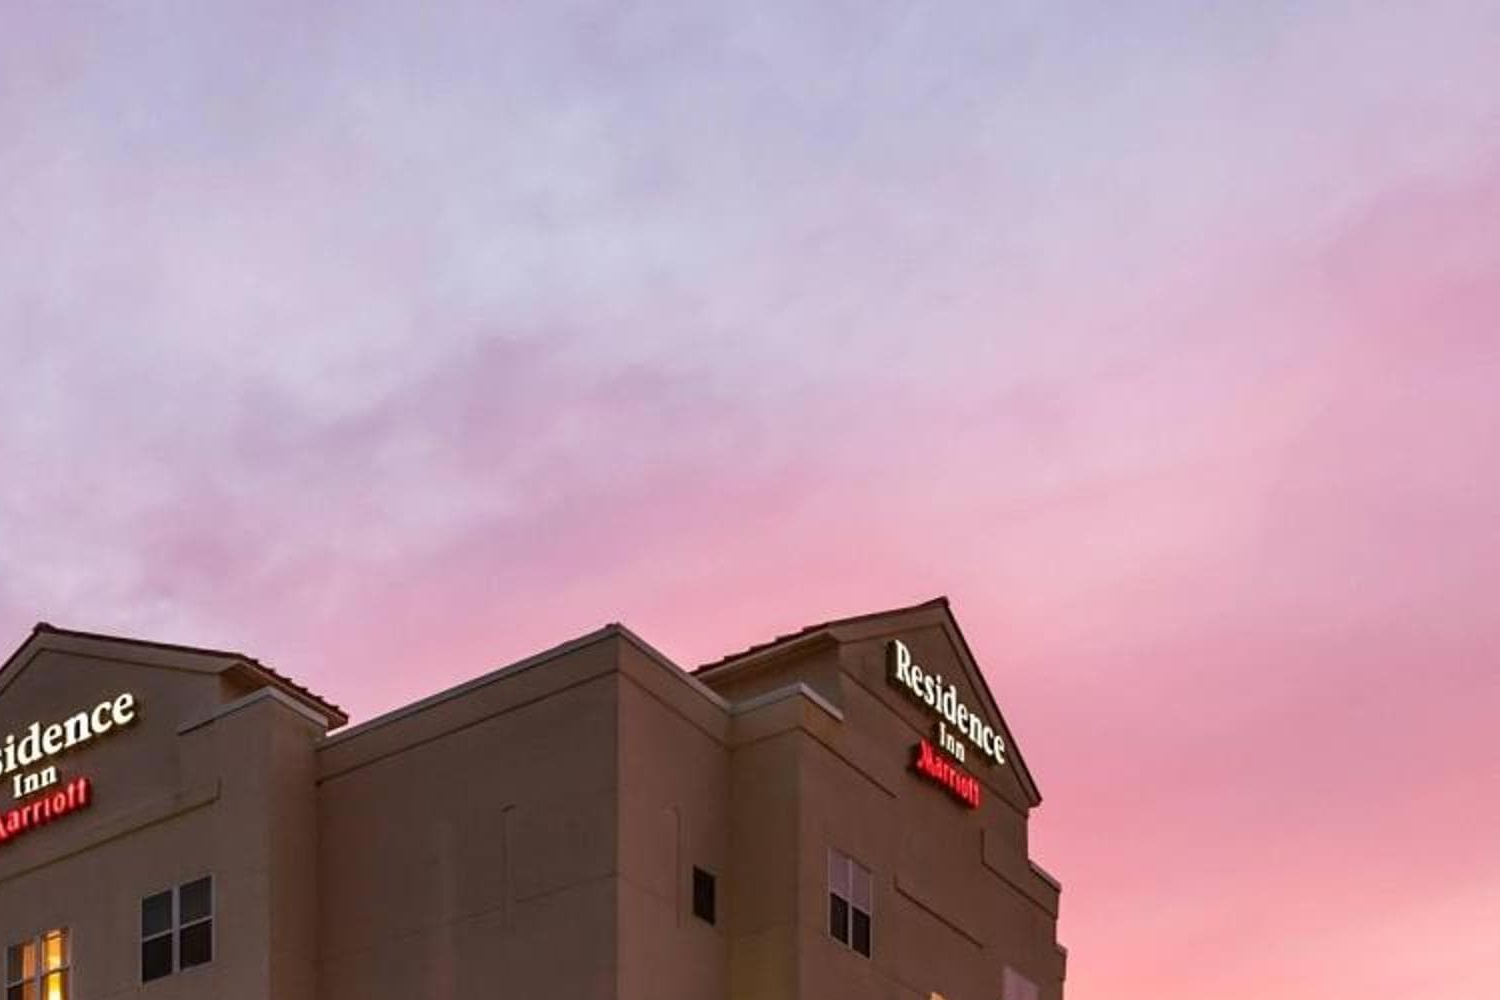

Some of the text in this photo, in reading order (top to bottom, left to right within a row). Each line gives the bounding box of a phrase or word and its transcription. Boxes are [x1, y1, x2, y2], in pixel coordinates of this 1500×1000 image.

[895, 639, 1005, 765] Residence
[938, 721, 966, 763] Inn
[13, 765, 58, 798] Inn
